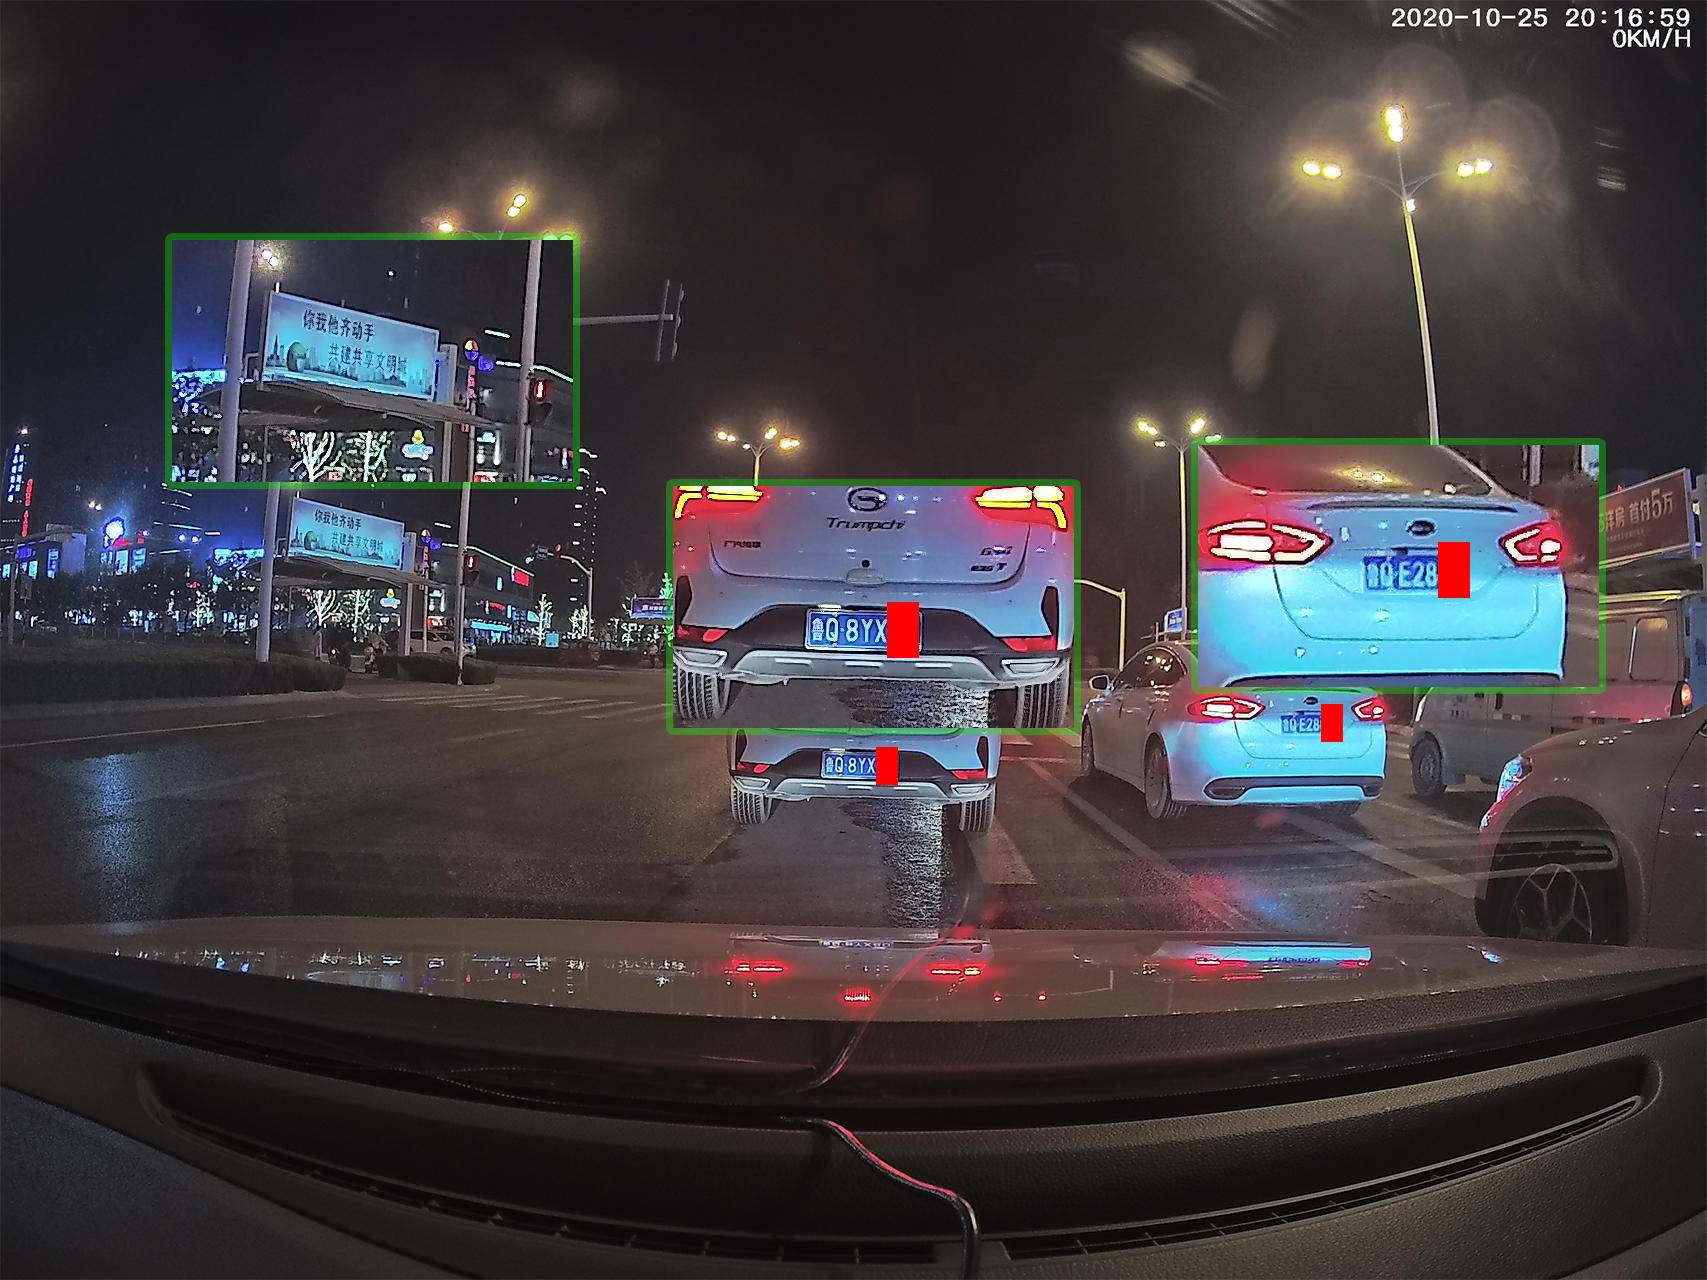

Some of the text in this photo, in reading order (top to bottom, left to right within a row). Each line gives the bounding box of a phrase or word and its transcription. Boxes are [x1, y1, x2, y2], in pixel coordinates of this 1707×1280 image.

[303, 309, 375, 342] 你我他齐动手
[328, 343, 407, 375] 共建共享文明城
[812, 617, 888, 643] 鲁Q·8YX
